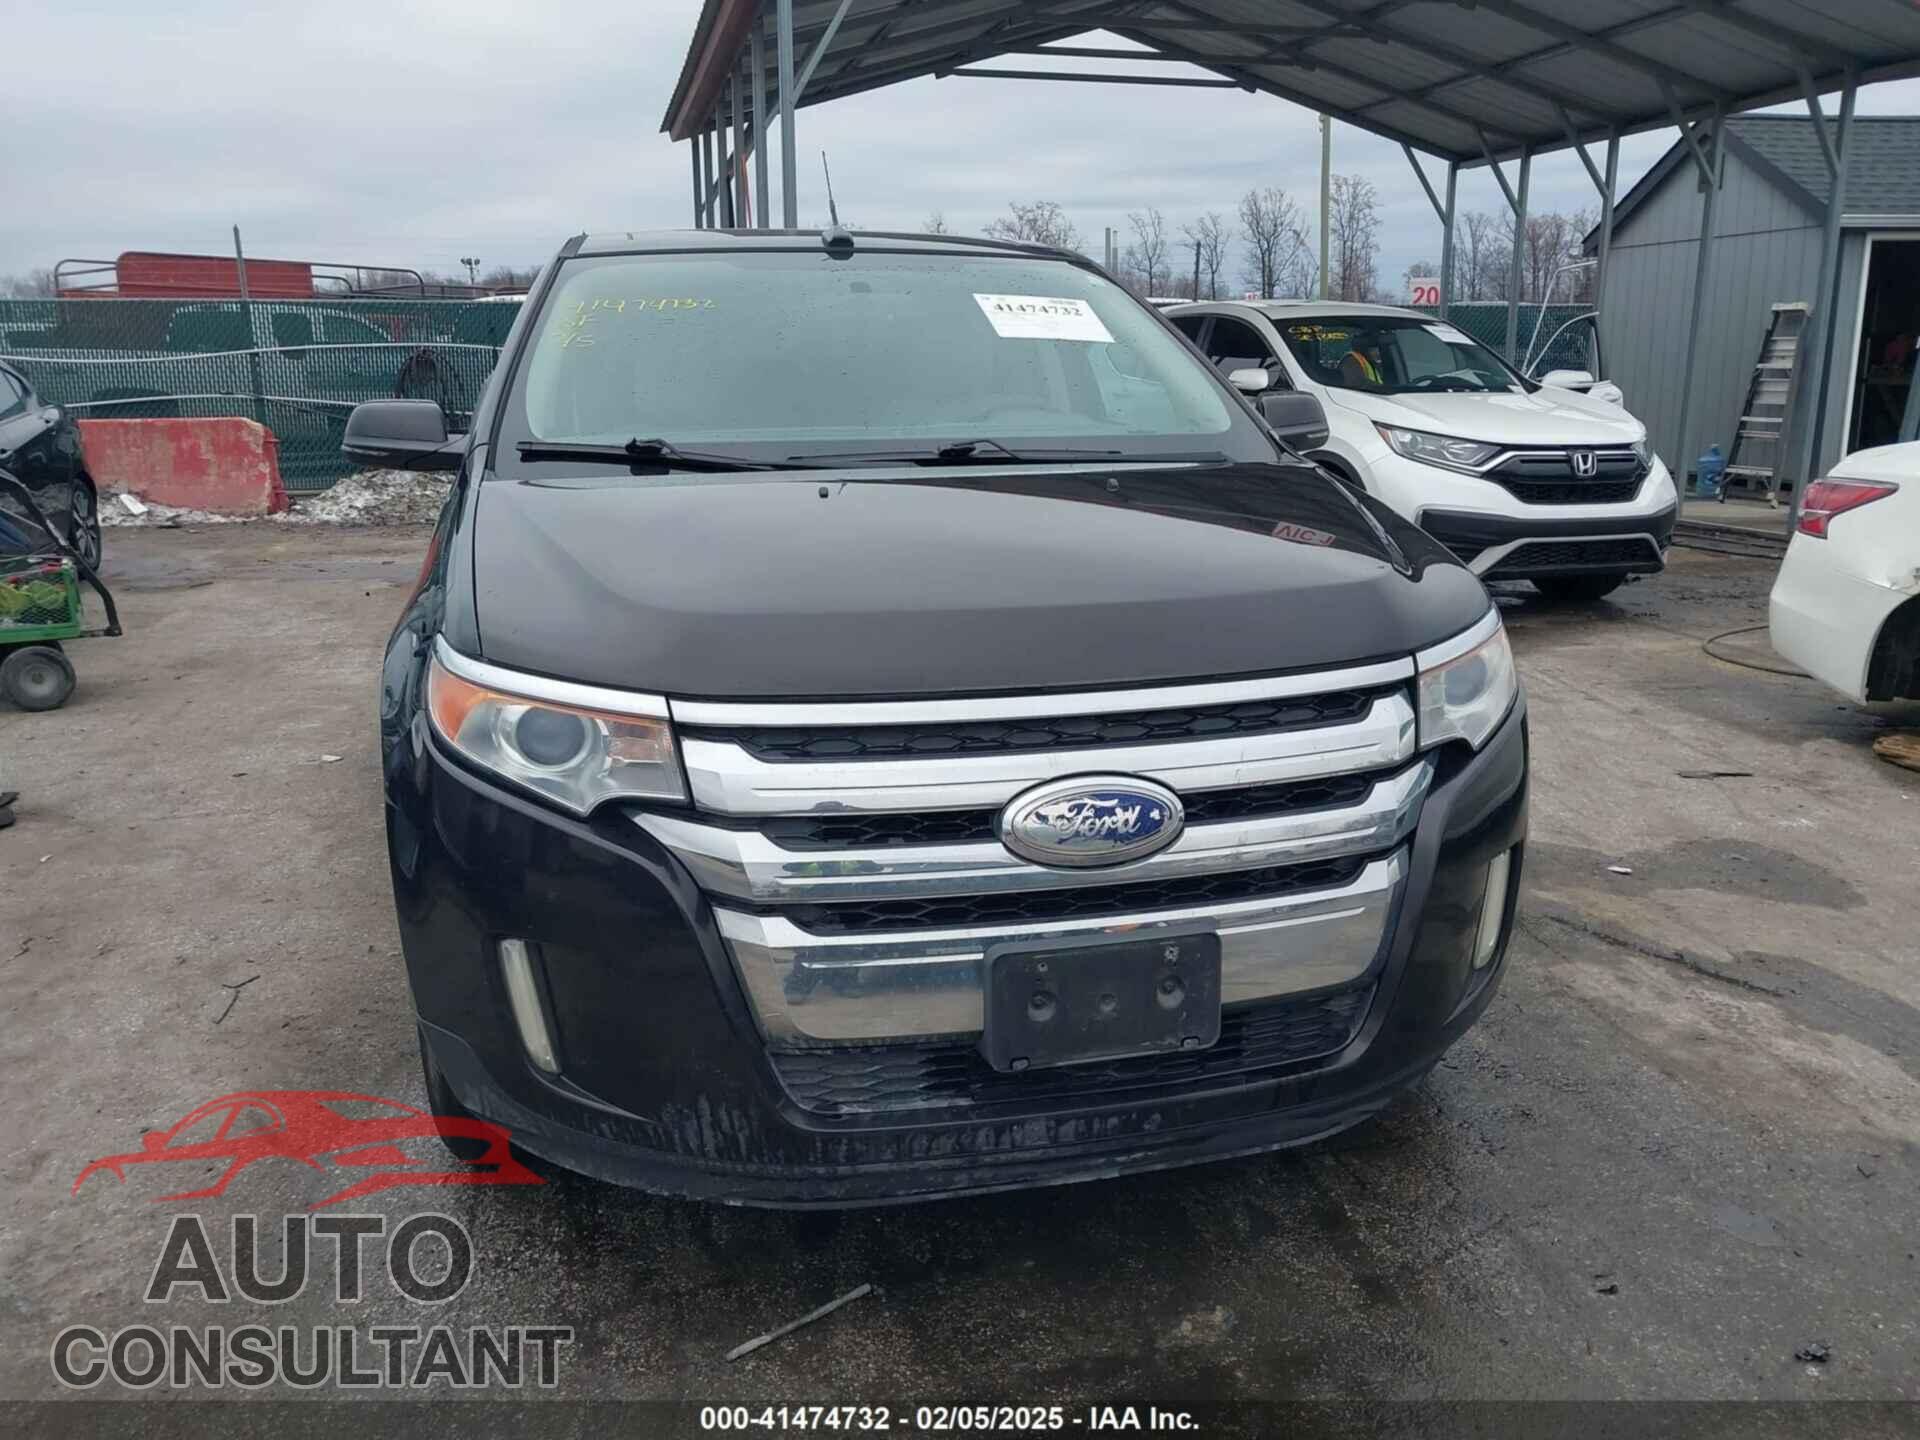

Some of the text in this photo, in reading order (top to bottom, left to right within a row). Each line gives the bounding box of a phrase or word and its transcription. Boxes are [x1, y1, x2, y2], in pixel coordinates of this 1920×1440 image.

[1412, 286, 1440, 305] 20
[993, 303, 1083, 317] 41474732
[1056, 798, 1142, 836] Ford
